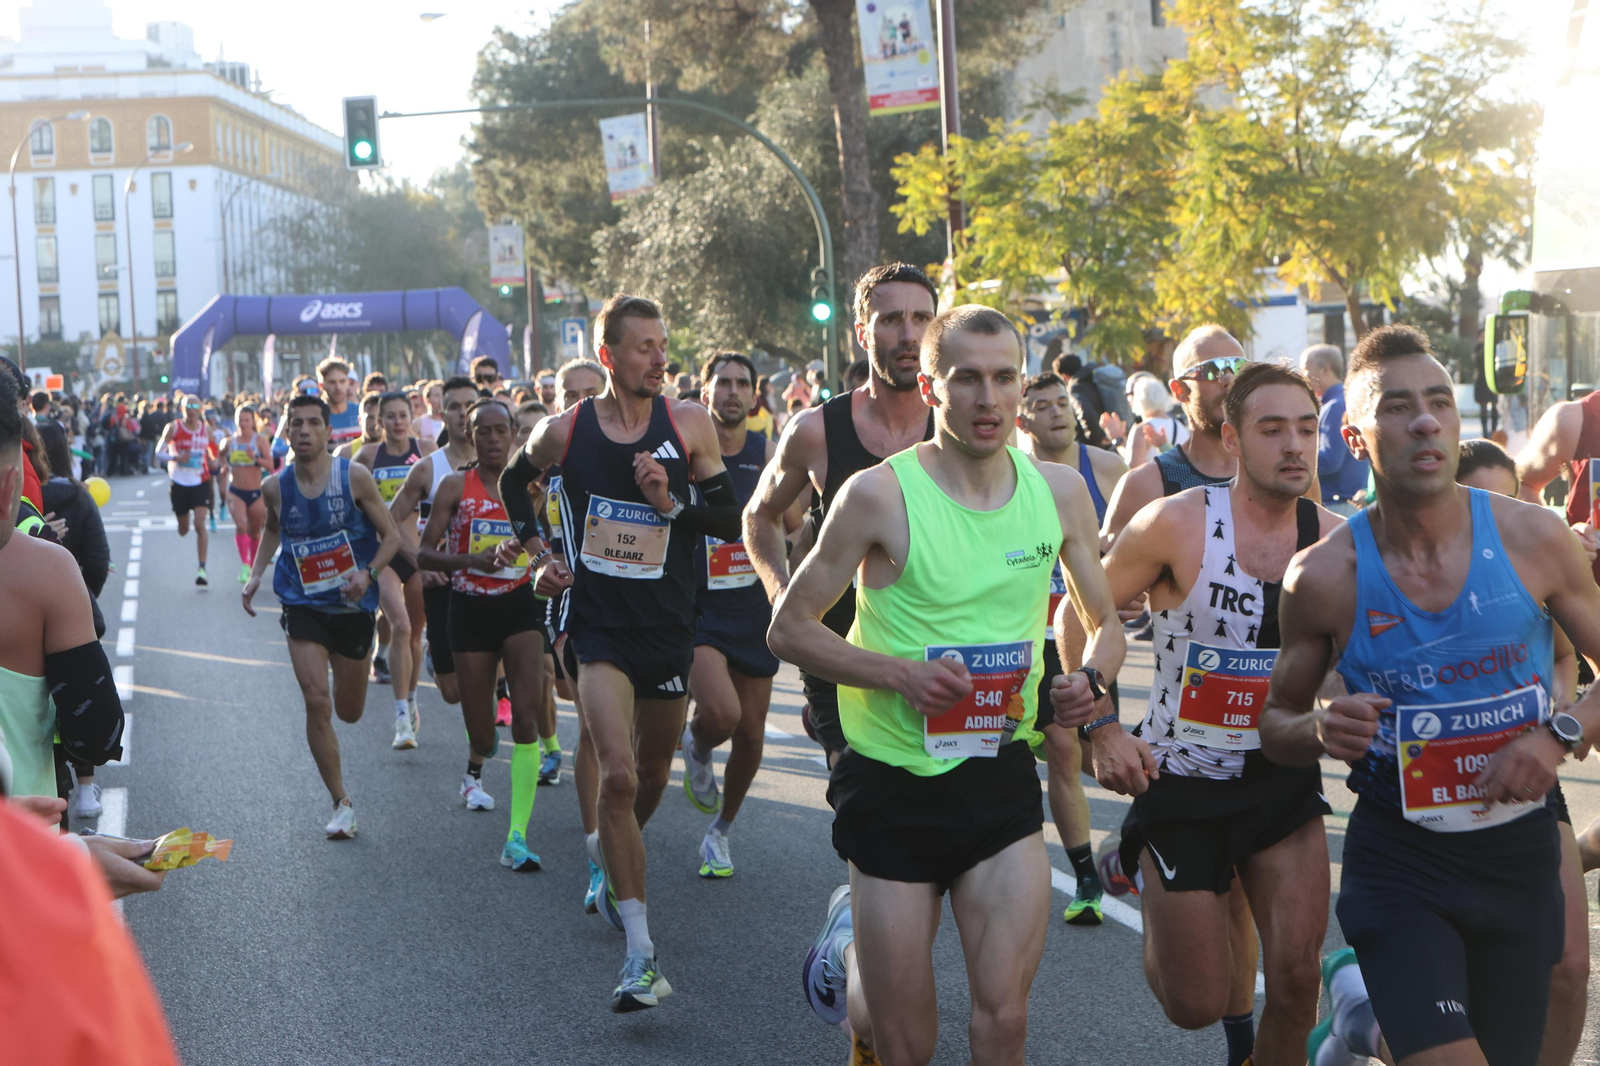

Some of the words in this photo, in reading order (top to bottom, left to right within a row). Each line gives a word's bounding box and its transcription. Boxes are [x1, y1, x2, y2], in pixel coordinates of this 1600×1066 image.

[320, 302, 363, 319] asics
[565, 321, 582, 343] P
[617, 508, 660, 523] ZURICH
[311, 538, 341, 552] ZURICH
[617, 533, 637, 546] 152
[604, 548, 644, 561] OLEJARZ
[1208, 581, 1256, 617] TRC
[971, 650, 1025, 668] ZURICH
[1226, 658, 1275, 671] ZURIC
[975, 690, 1003, 707] 540
[1227, 691, 1254, 706] 715
[1223, 713, 1251, 726] LUIS
[1450, 703, 1525, 731] ZURICH
[1432, 786, 1453, 803] EL
